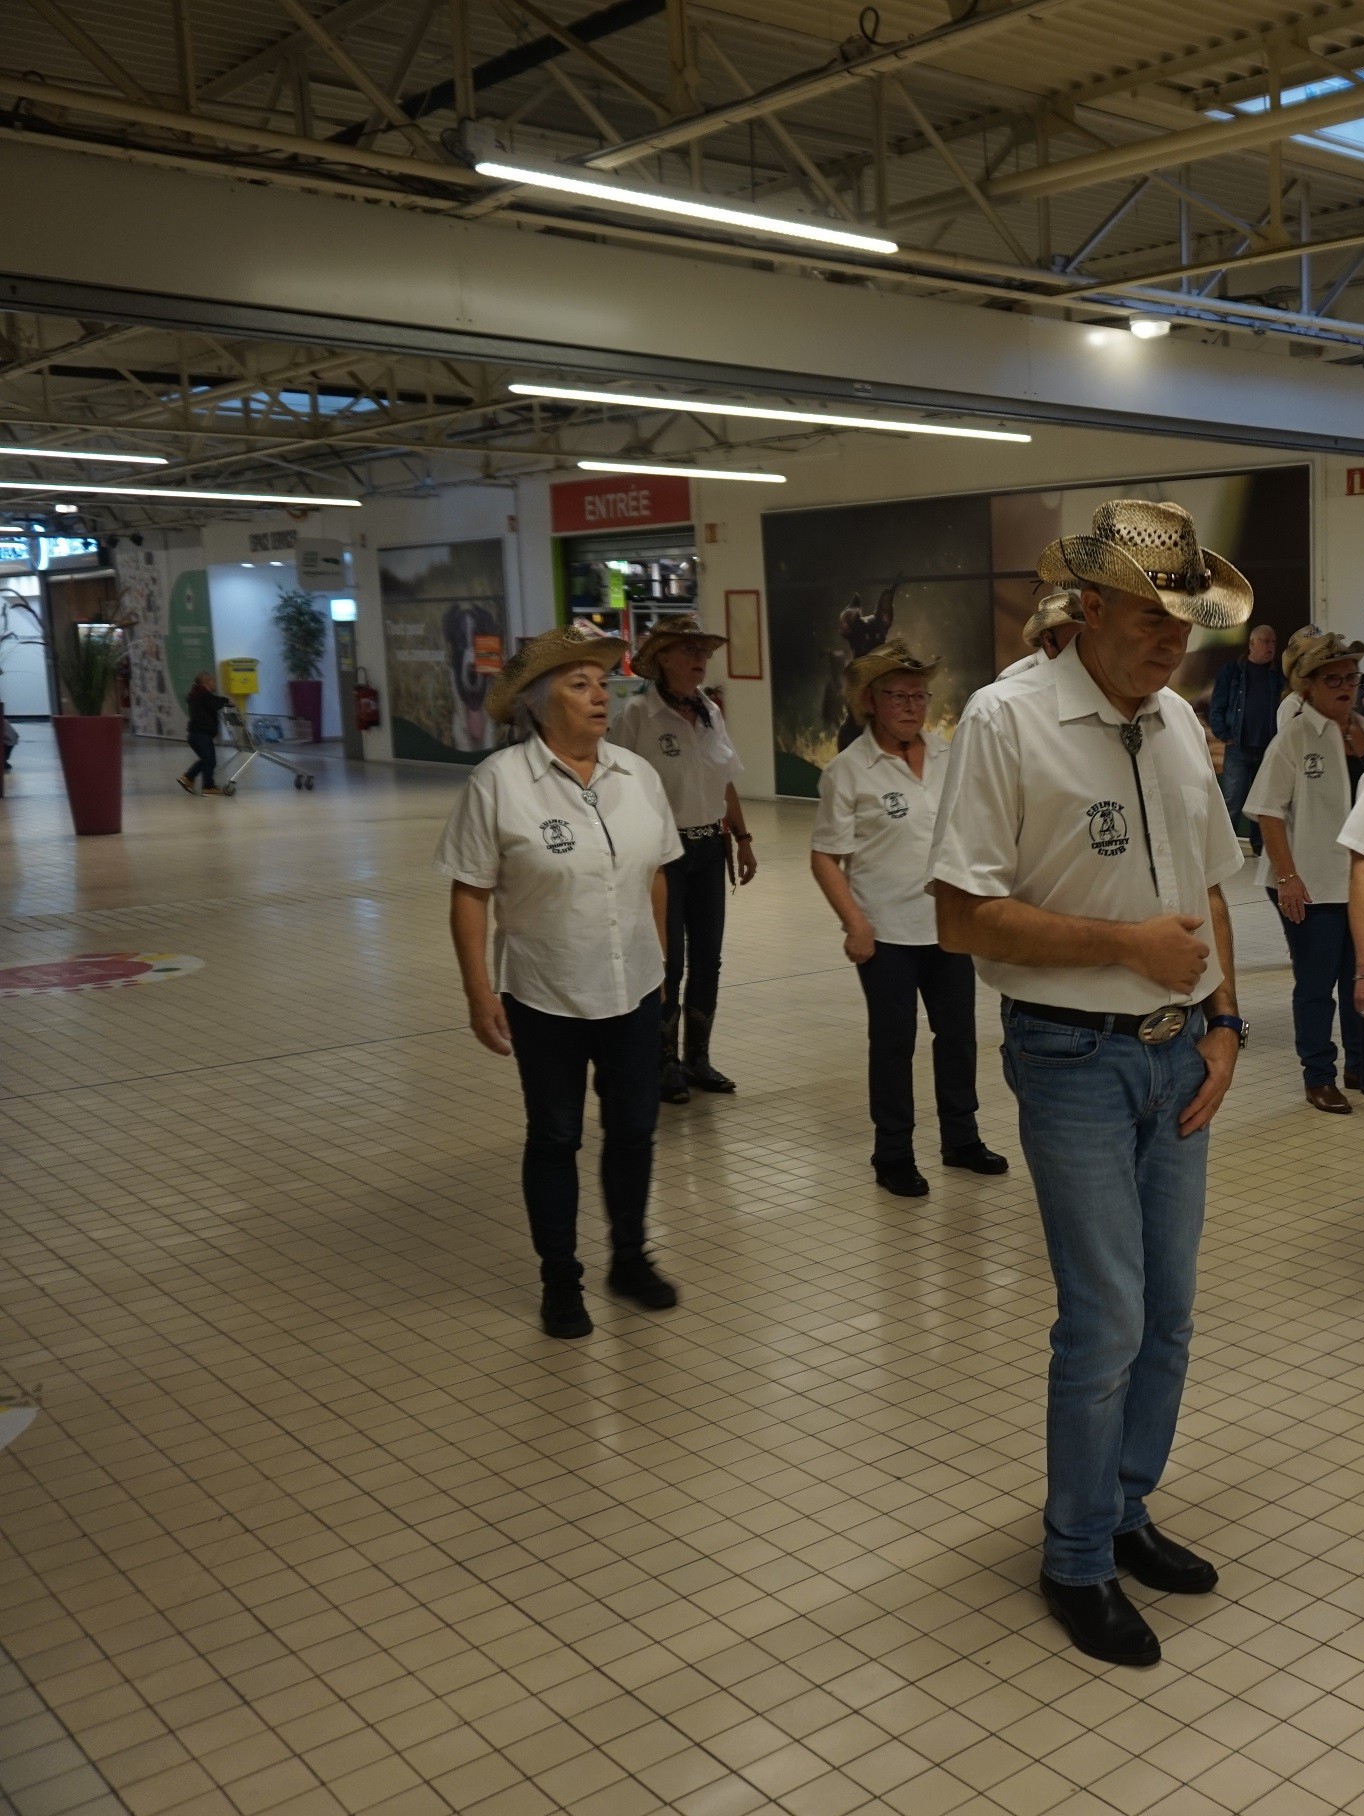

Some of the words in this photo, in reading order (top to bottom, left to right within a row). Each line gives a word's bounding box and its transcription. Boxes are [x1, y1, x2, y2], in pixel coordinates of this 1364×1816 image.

[584, 484, 651, 521] ENTRÉE
[1086, 800, 1125, 817] CUINCY
[1091, 837, 1130, 849] COUNTRY
[1097, 845, 1127, 857] CLUB
